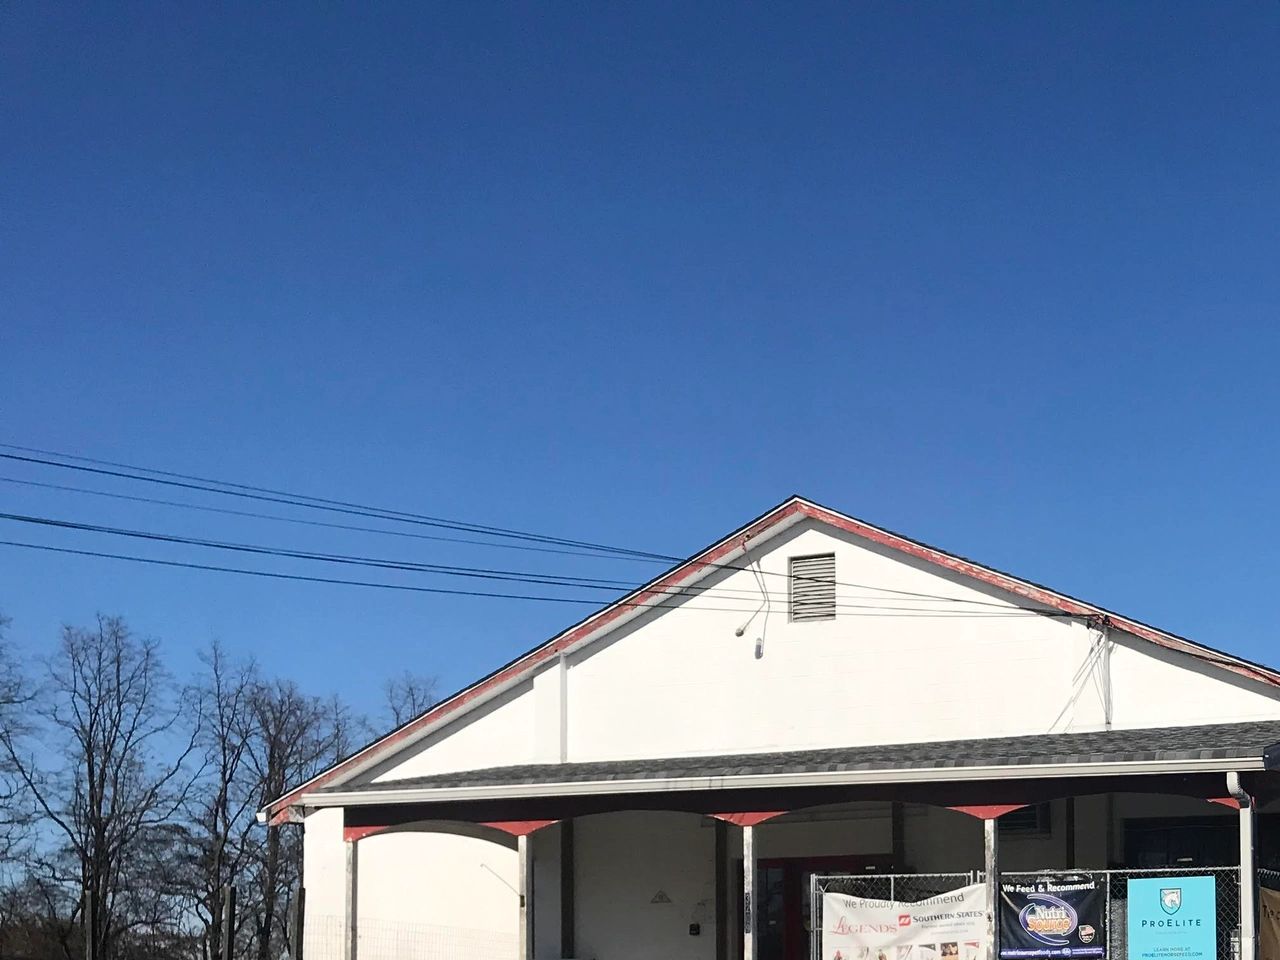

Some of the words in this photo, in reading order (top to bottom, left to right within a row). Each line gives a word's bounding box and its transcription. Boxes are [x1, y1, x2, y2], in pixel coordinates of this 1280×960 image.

[1002, 884, 1014, 893] We
[1016, 884, 1035, 893] Feed
[1038, 884, 1045, 893] &
[1047, 881, 1095, 892] Recommend
[844, 899, 857, 909] We
[912, 913, 954, 923] SOUTHERN
[956, 910, 983, 919] STATES
[1035, 905, 1067, 919] Nutri
[1027, 918, 1071, 931] Source
